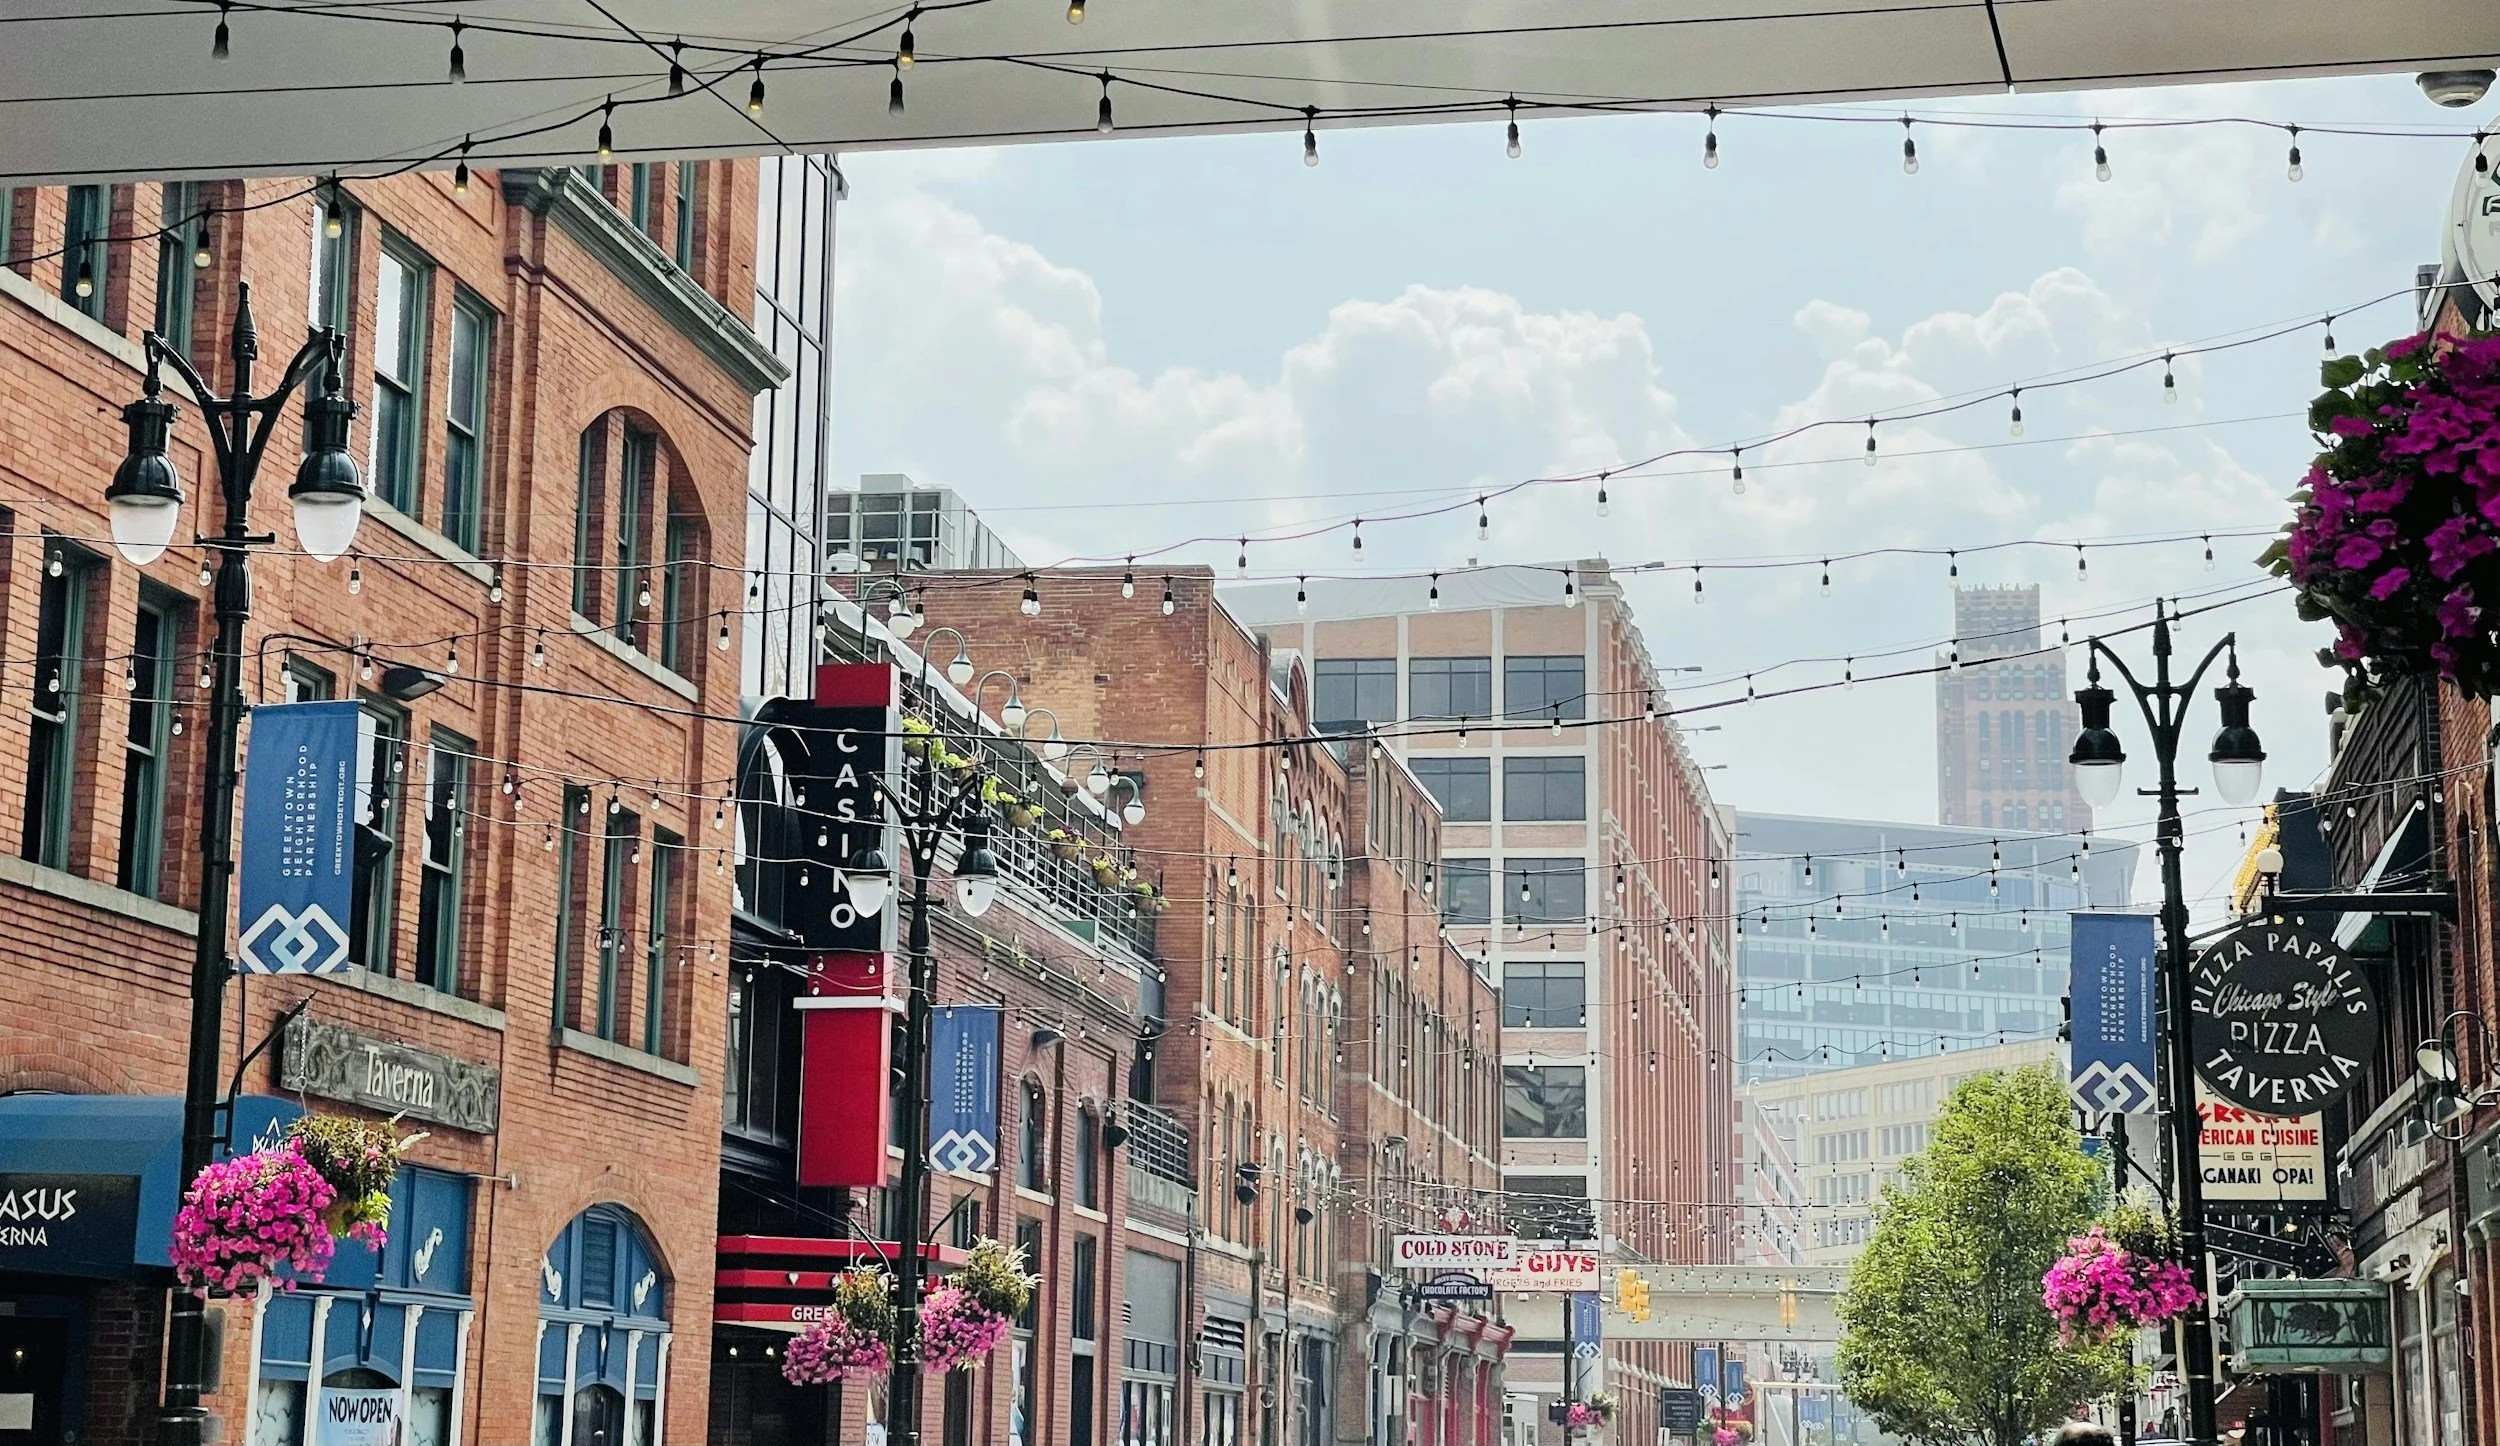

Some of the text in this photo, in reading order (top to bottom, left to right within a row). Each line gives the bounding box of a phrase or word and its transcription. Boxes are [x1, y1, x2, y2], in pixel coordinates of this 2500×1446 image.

[282, 776, 295, 877] GREEKTOWN
[294, 744, 308, 877] NEIGHBORHOOD
[305, 762, 318, 877] PARTNERSHIP
[334, 760, 346, 876] GREEKTOWNDETROIT.ORG
[830, 728, 860, 929] CASINO
[2191, 932, 2368, 1015] PIZZA PAPALIS
[2109, 944, 2117, 1042] NEIGHBORHOOD
[2213, 979, 2340, 1020] Chicago Style
[2230, 1021, 2327, 1055] PIZZA
[364, 1044, 434, 1109] Taverna
[2206, 1048, 2360, 1104] TAVERNA
[2199, 1129, 2319, 1146] ERICAN CUISINE
[2272, 1168, 2314, 1184] OPA!
[0, 1188, 77, 1221] ASUS
[0, 1226, 48, 1247] ERNA
[1401, 1240, 1509, 1260] COLD STONE
[1528, 1254, 1597, 1273] GUYS
[1421, 1286, 1489, 1297] CHOCOLATE FACTORY
[1554, 1279, 1583, 1288] FRIES
[329, 1396, 393, 1424] NOW OPEN
